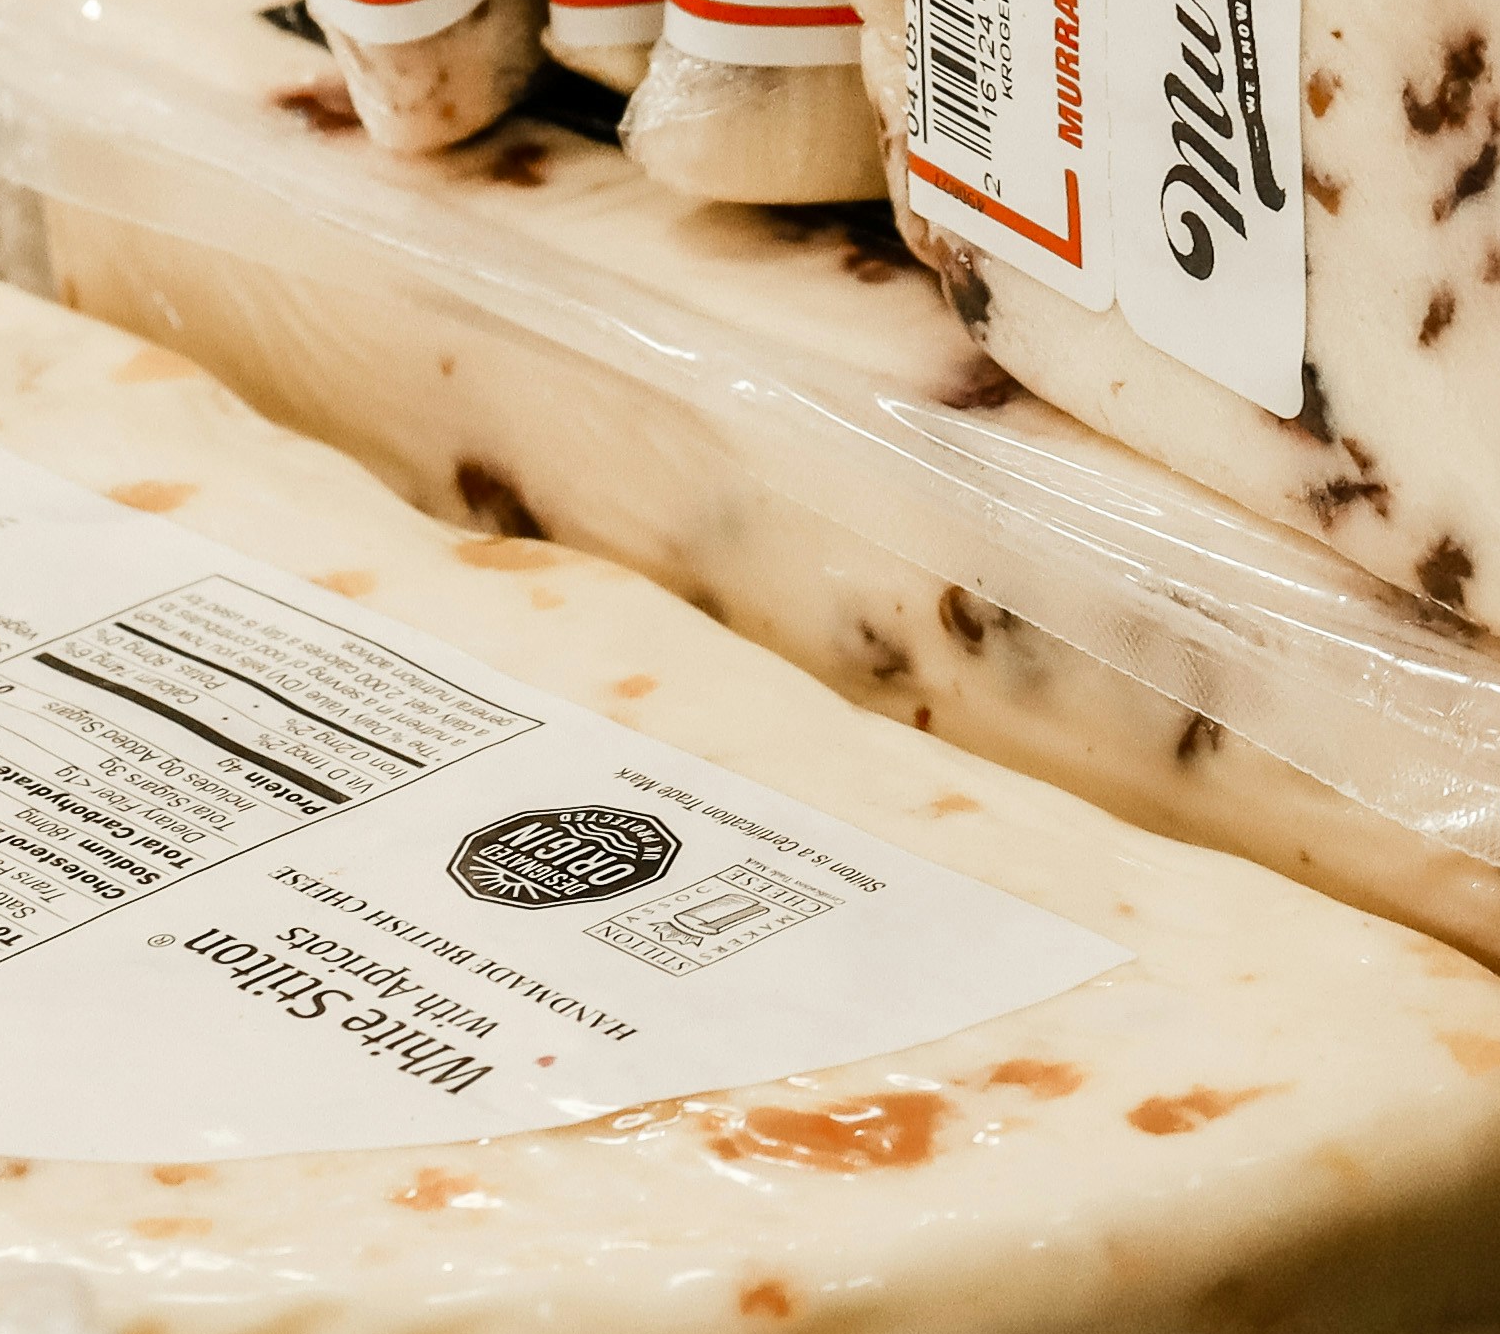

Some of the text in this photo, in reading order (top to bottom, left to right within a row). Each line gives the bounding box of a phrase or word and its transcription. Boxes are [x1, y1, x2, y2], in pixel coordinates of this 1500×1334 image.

[976, 12, 998, 117] 16124
[1233, 0, 1254, 70] KNOW
[1244, 79, 1256, 114] WE
[982, 171, 1001, 198] 2
[41, 701, 258, 813] Includes 0g Added Sugars
[216, 757, 328, 815] Protein 4g
[53, 762, 207, 844] Dietary Fiber <1g
[97, 754, 236, 832] Total Sugars 3g
[550, 796, 668, 858] PROTECTED
[13, 805, 161, 885] Sodium 180mg
[128, 834, 194, 870] Total
[477, 842, 590, 896] DESIGNATED
[496, 820, 636, 886] ORIGIN
[714, 863, 822, 913] CHEESE
[271, 867, 638, 1041] HANDMADE BRITISH CHEESE
[596, 924, 691, 971] STILTON
[275, 925, 498, 1039] with Apricots
[340, 1007, 493, 1094] White
